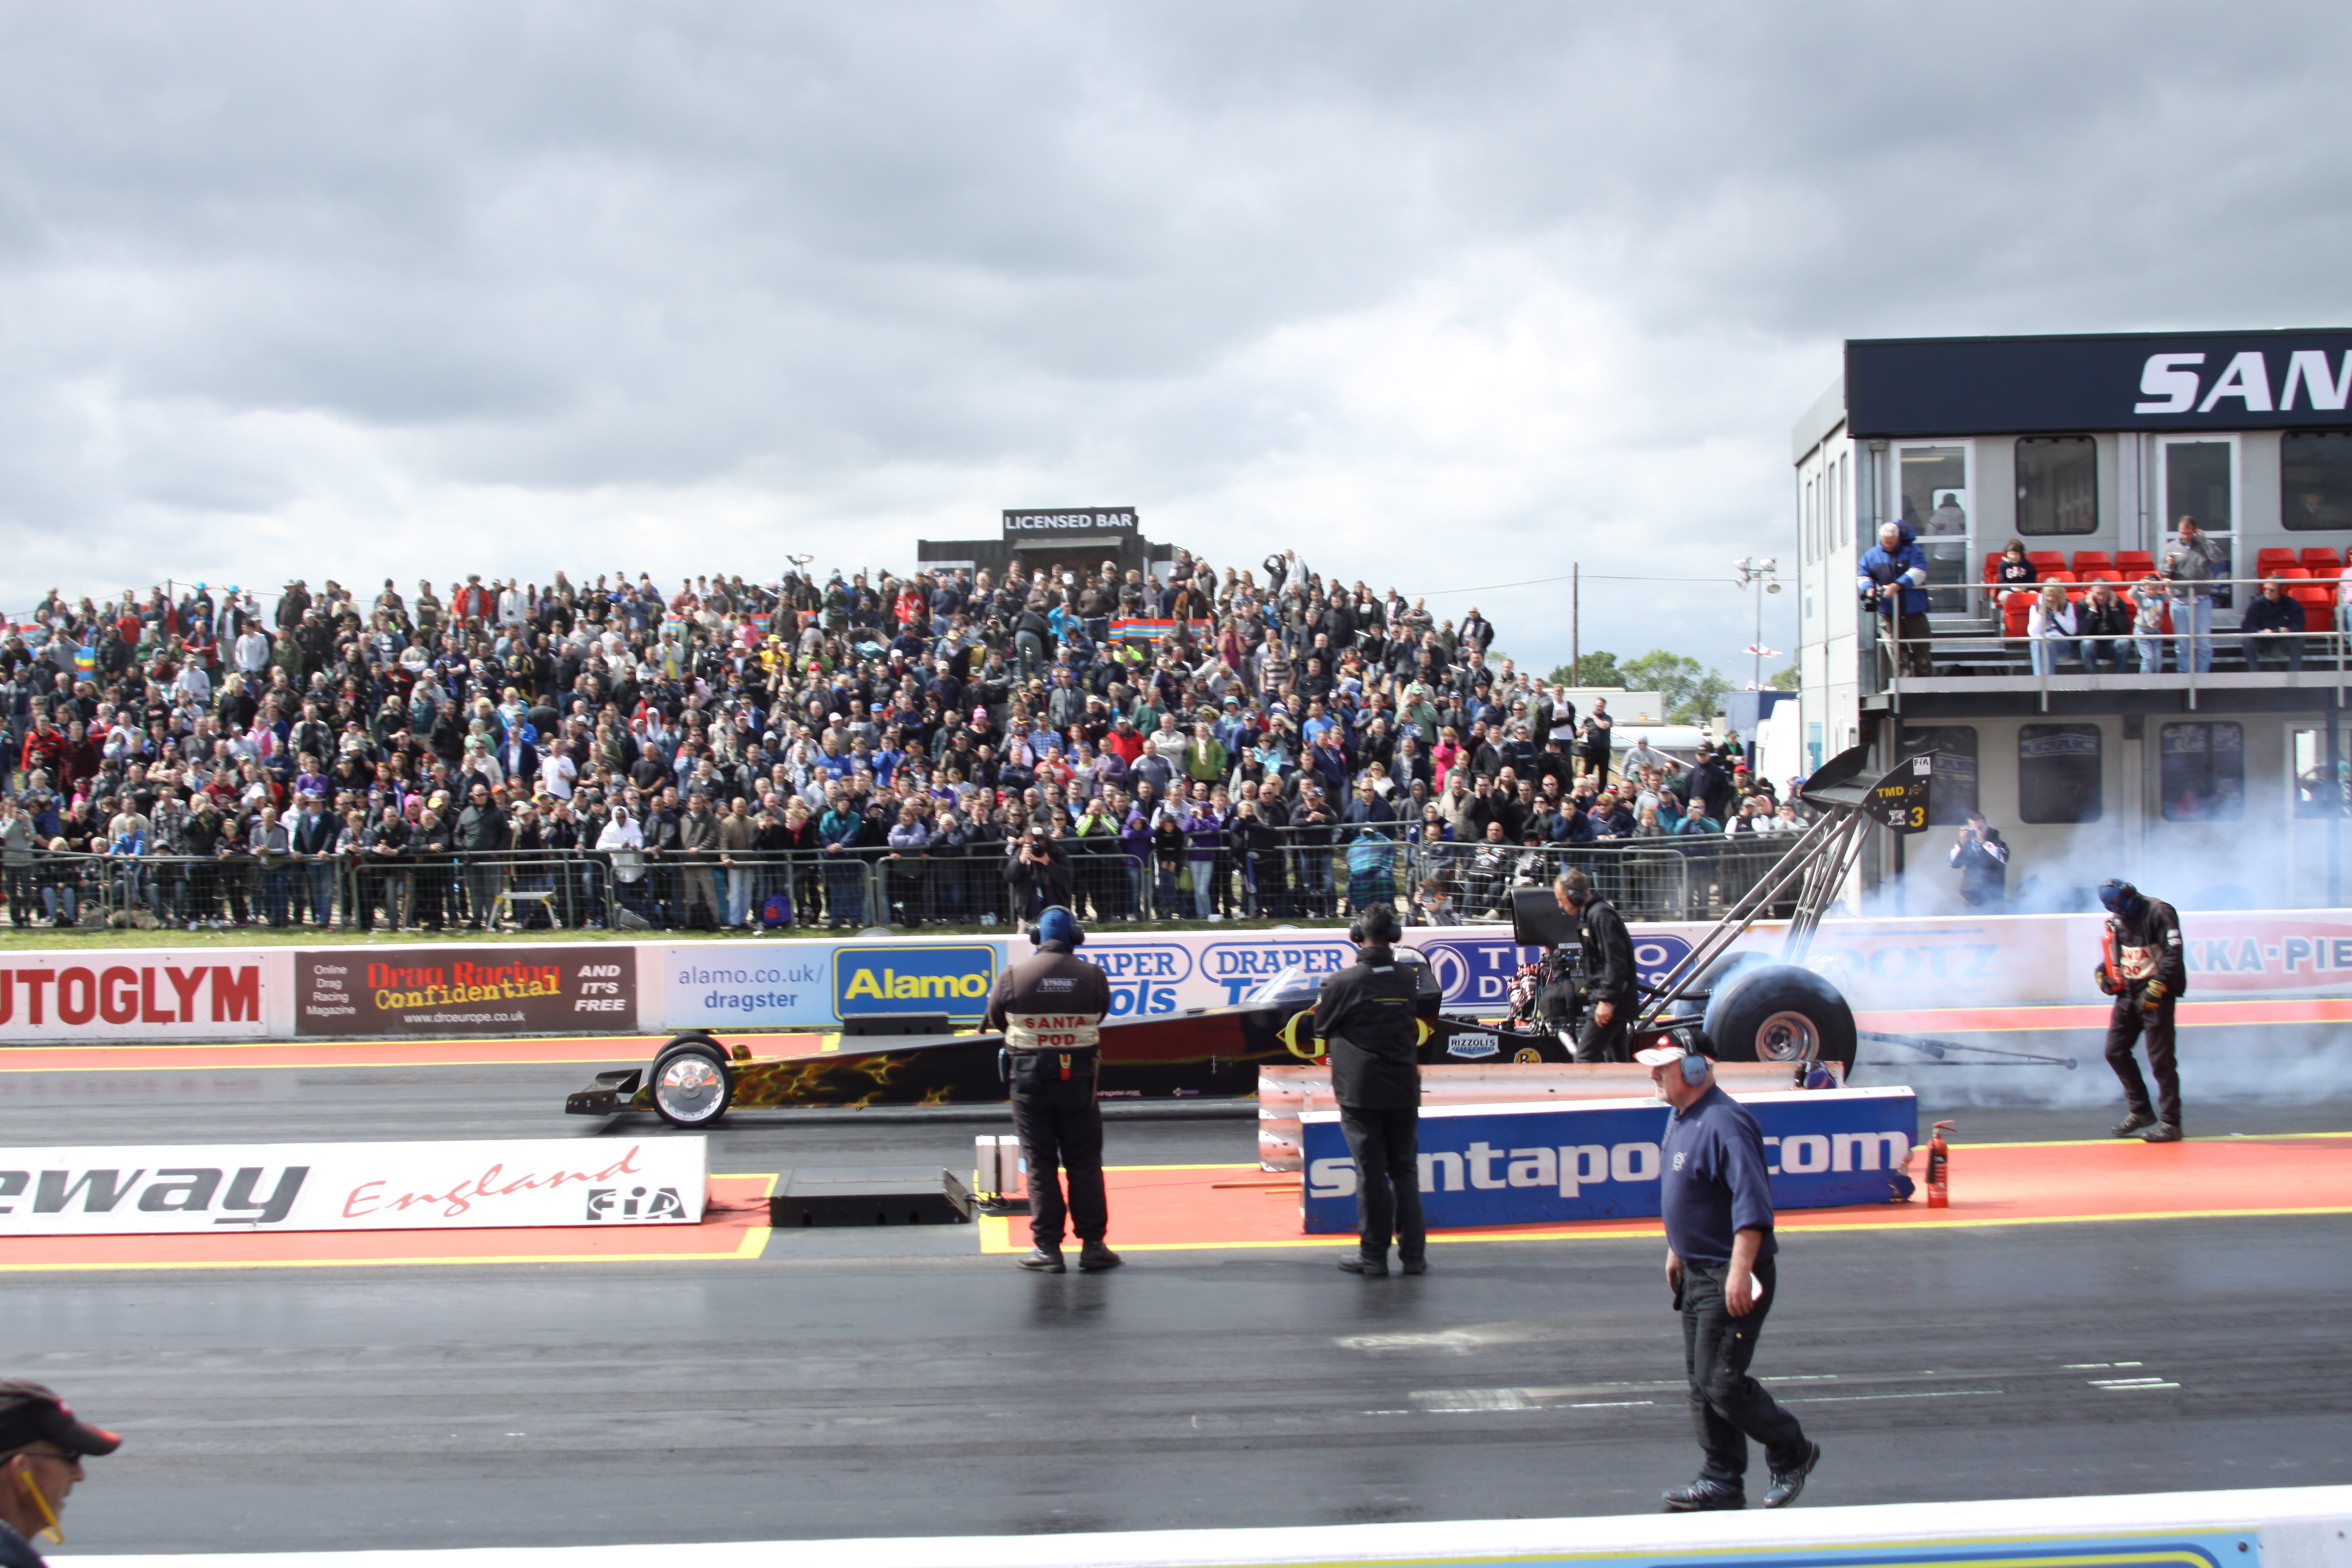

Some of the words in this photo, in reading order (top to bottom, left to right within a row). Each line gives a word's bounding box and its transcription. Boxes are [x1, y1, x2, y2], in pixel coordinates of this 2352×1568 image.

[2133, 350, 2352, 414] SAN
[1004, 514, 1092, 530] LICENSED
[1096, 513, 1133, 527] BAR
[1876, 785, 1905, 798] TMD
[1909, 806, 1925, 827] 3
[313, 965, 348, 975] Online
[1077, 952, 1177, 976] APER
[1216, 949, 1343, 974] DRAPER
[367, 962, 443, 989] Drag
[453, 961, 561, 989] Racing
[577, 965, 620, 977] AND
[678, 964, 825, 985] alamo.co.uk/
[316, 978, 342, 991] Drag
[581, 982, 619, 995] IT'S
[844, 968, 988, 999] Alamo
[313, 991, 349, 1003] Racing
[375, 975, 561, 1010] Confidential
[1107, 979, 1176, 1016] ols
[574, 999, 626, 1012] FREE
[704, 991, 798, 1012] dragster
[306, 1004, 356, 1017] Magazine
[404, 1010, 525, 1024] www.drceurope.co.uk
[1024, 1016, 1086, 1029] SANTA
[1037, 1034, 1076, 1046] POD
[341, 1145, 642, 1219] England
